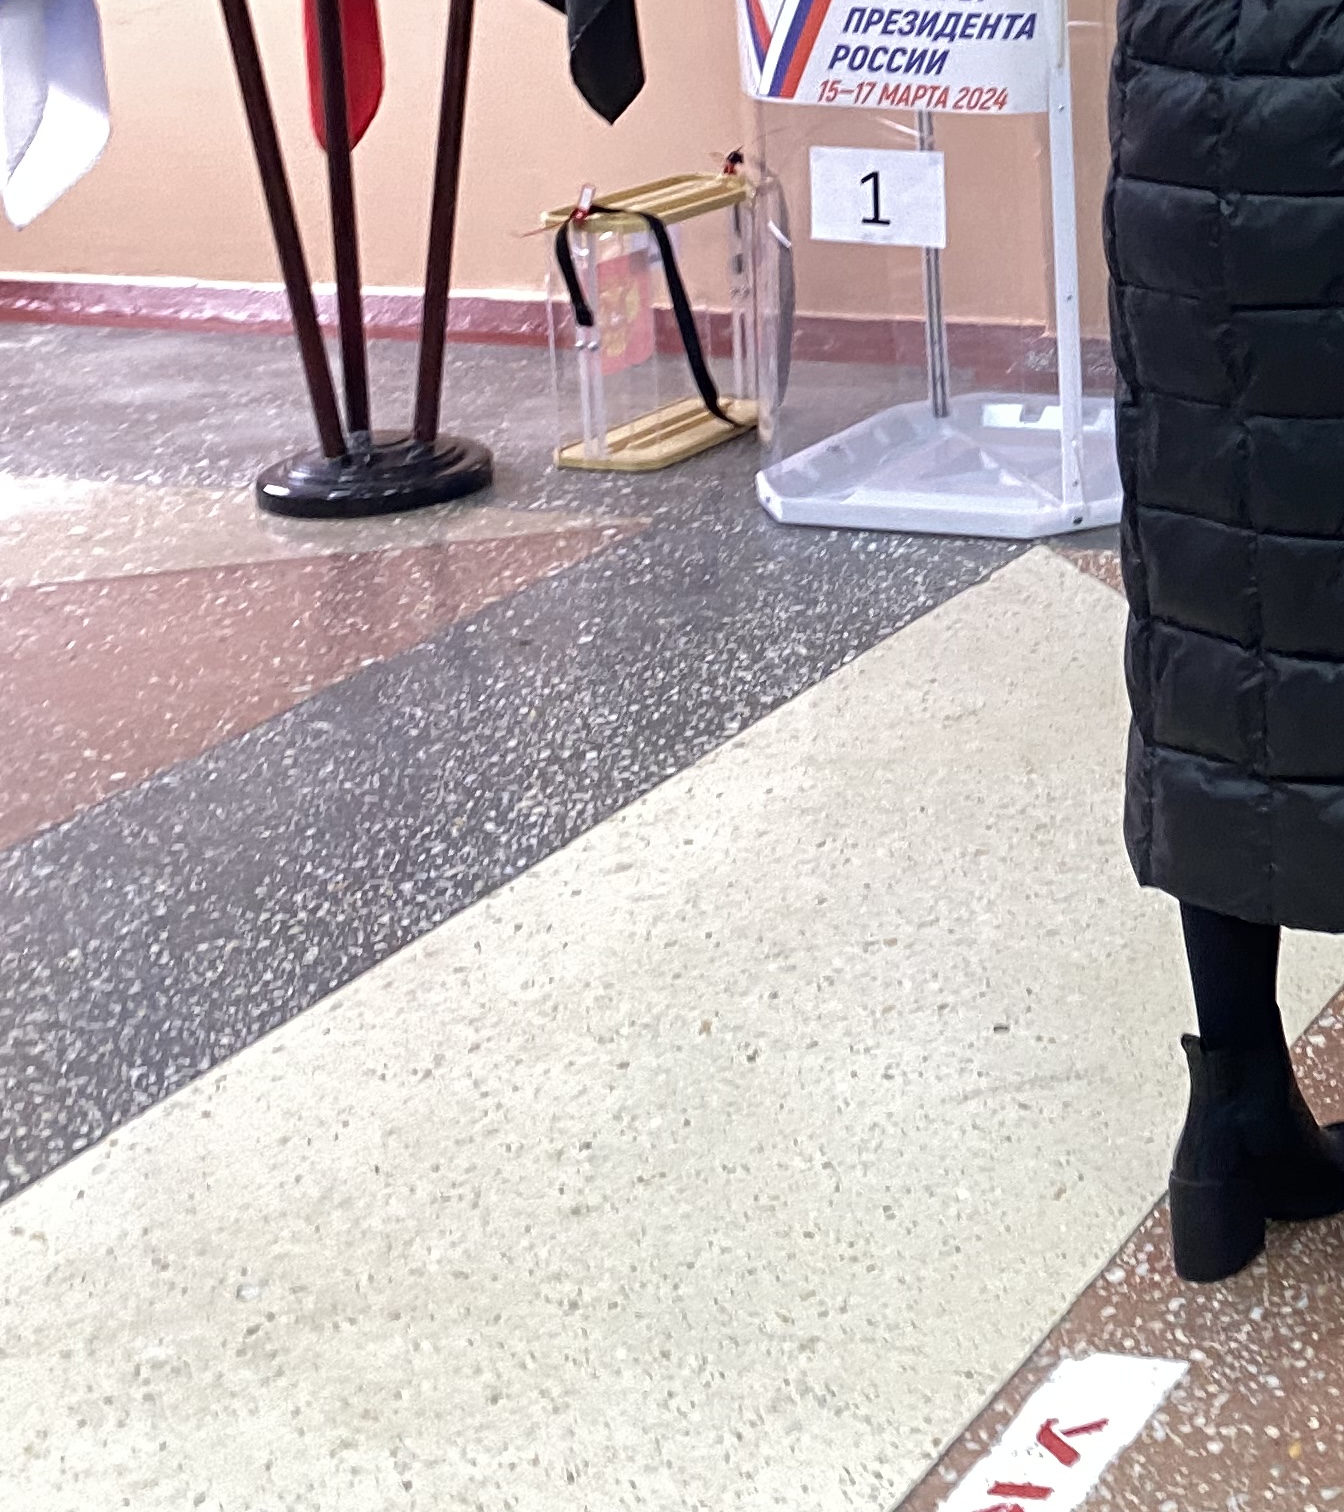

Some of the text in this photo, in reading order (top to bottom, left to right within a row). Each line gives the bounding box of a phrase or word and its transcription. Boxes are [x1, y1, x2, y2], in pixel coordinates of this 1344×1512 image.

[842, 7, 1038, 42] ПРЕЗИДЕНТА
[827, 44, 950, 76] РОССИИ
[877, 82, 949, 109] МАРТА
[951, 86, 1009, 111] 2024
[859, 170, 891, 226] 1
